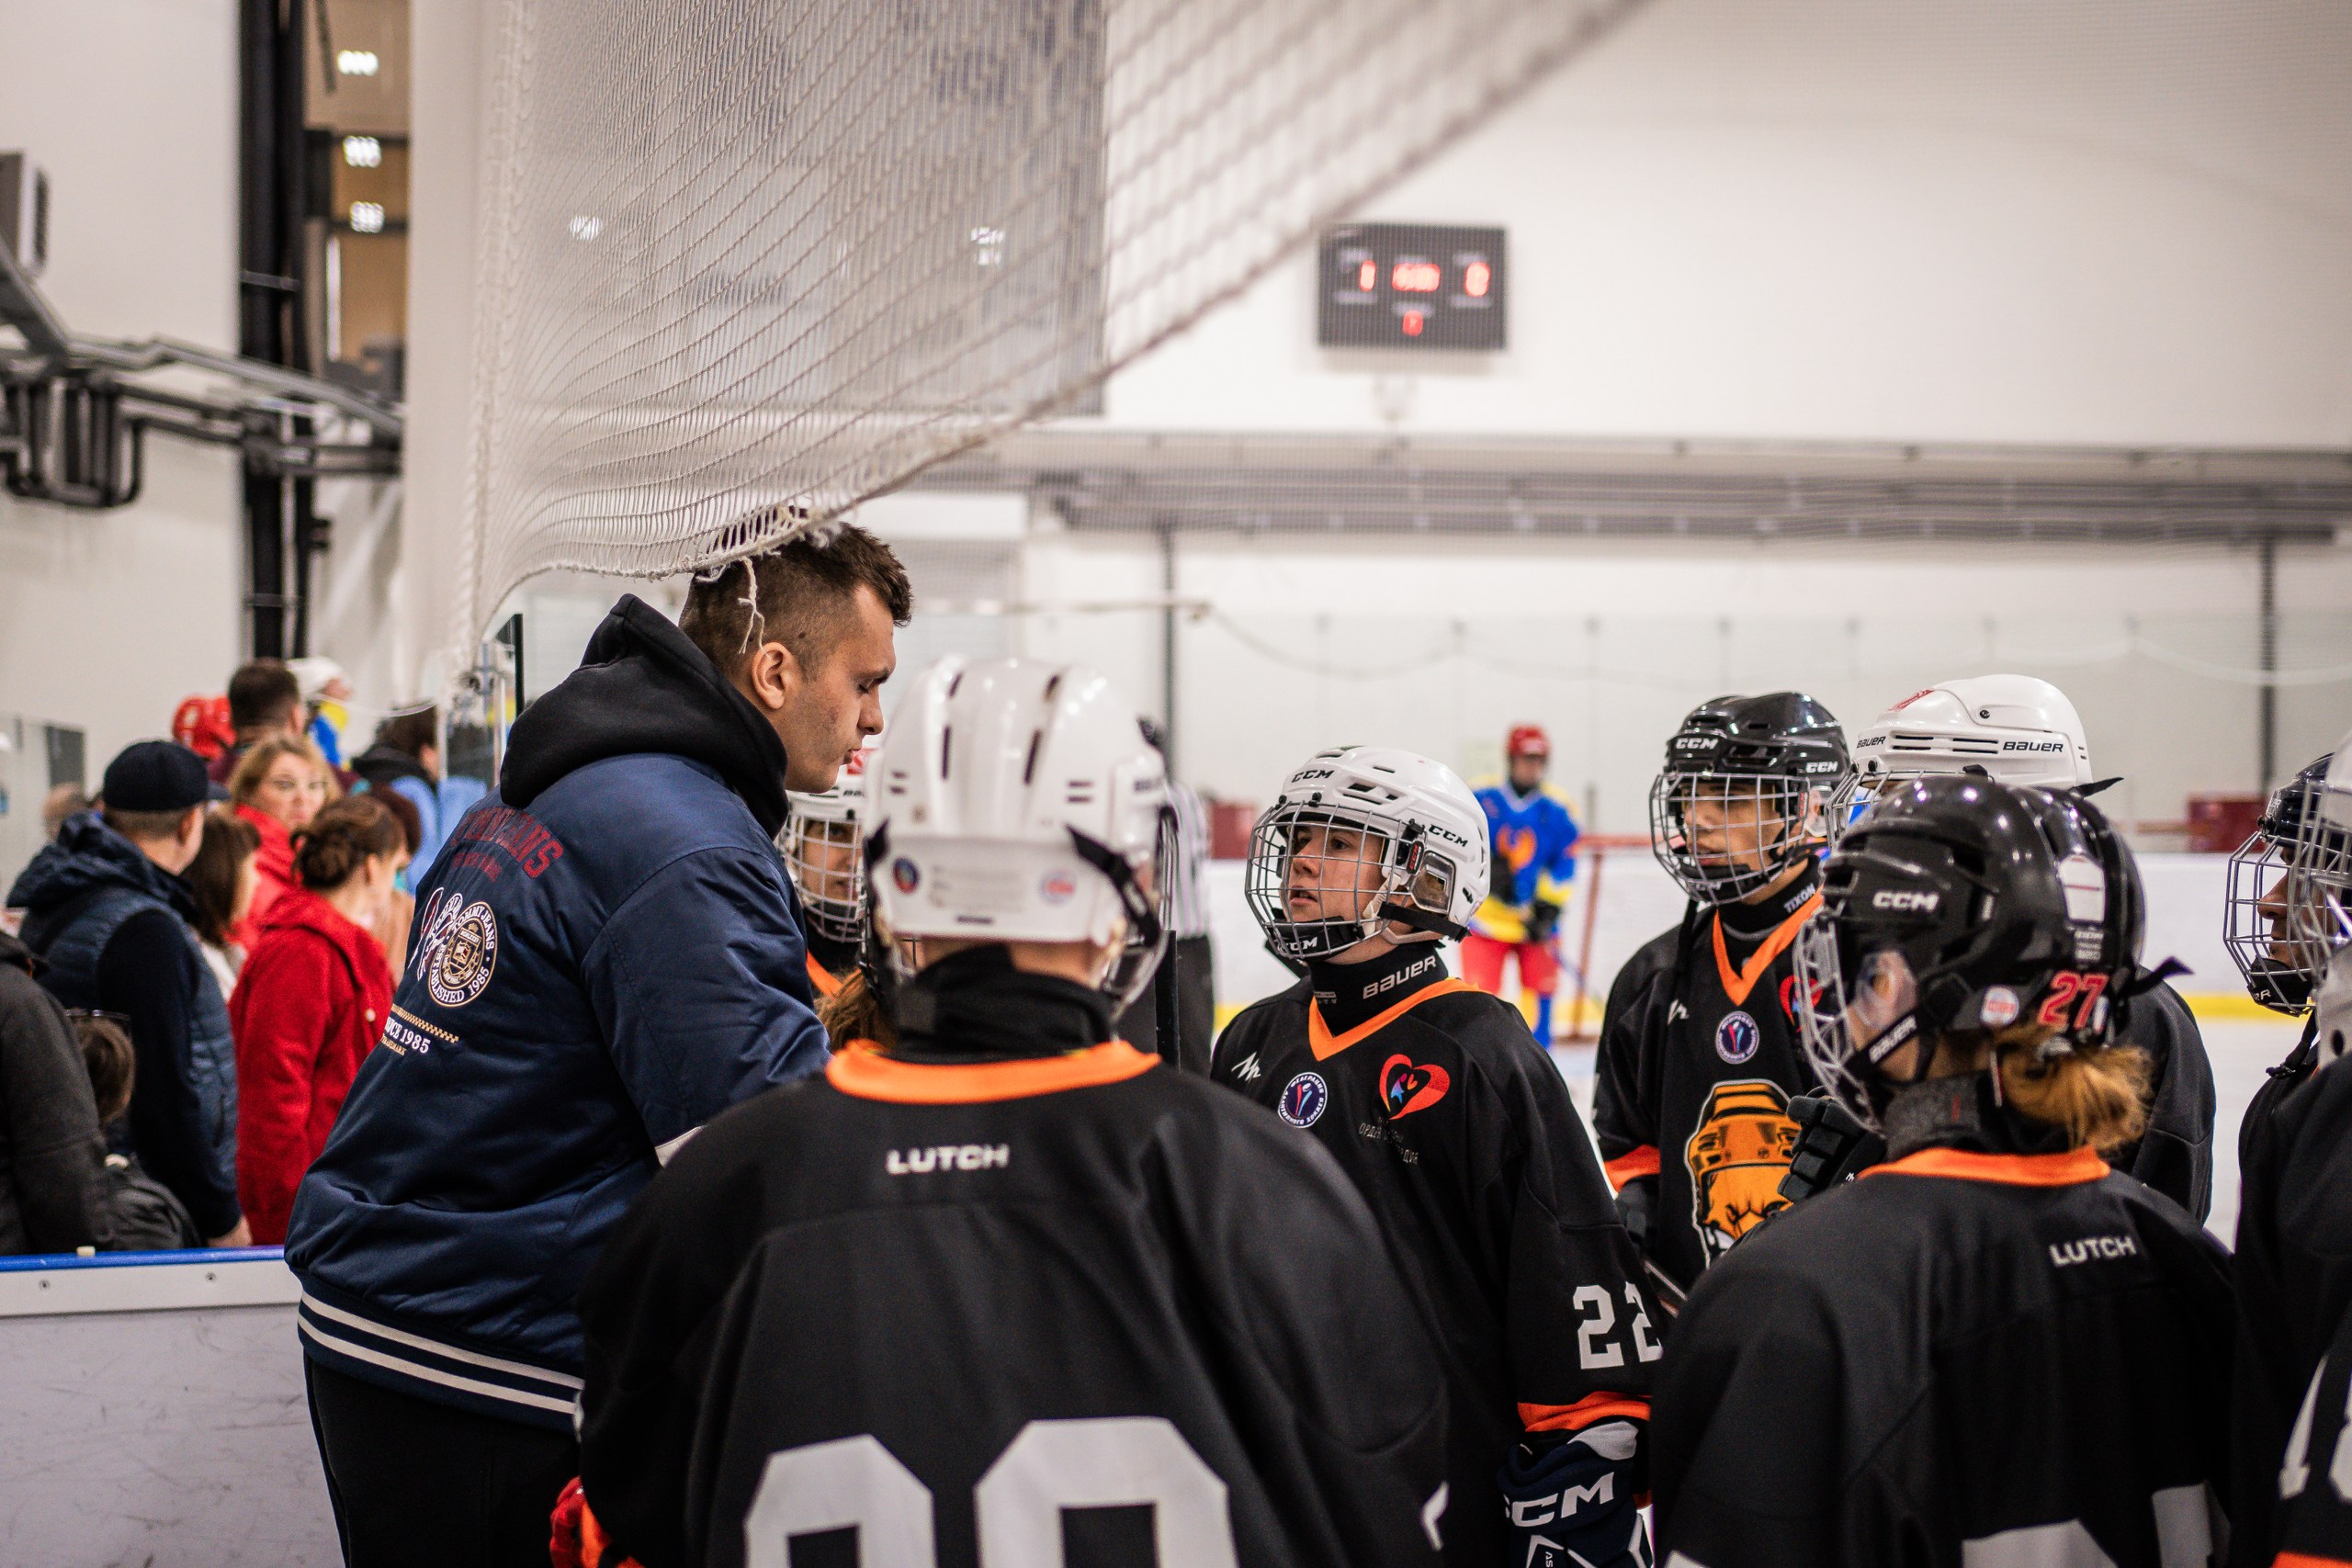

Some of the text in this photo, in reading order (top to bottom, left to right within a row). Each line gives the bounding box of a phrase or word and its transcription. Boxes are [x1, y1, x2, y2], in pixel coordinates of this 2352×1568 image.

[1676, 739, 1719, 750] CCM
[1857, 737, 1886, 749] BAUER
[2003, 741, 2064, 753] BAUER
[1291, 769, 1335, 784] CCM
[1805, 761, 1838, 773] CCM
[1428, 824, 1469, 848] CCM
[1872, 889, 1940, 911] CCM
[467, 965, 490, 997] 1985
[1363, 955, 1437, 999] BAUER
[2036, 969, 2109, 1031] 27
[400, 1028, 432, 1055] 1985
[888, 1144, 1010, 1175] LUTCH
[2049, 1235, 2138, 1268] LUTCH
[1572, 1280, 1663, 1370] 22
